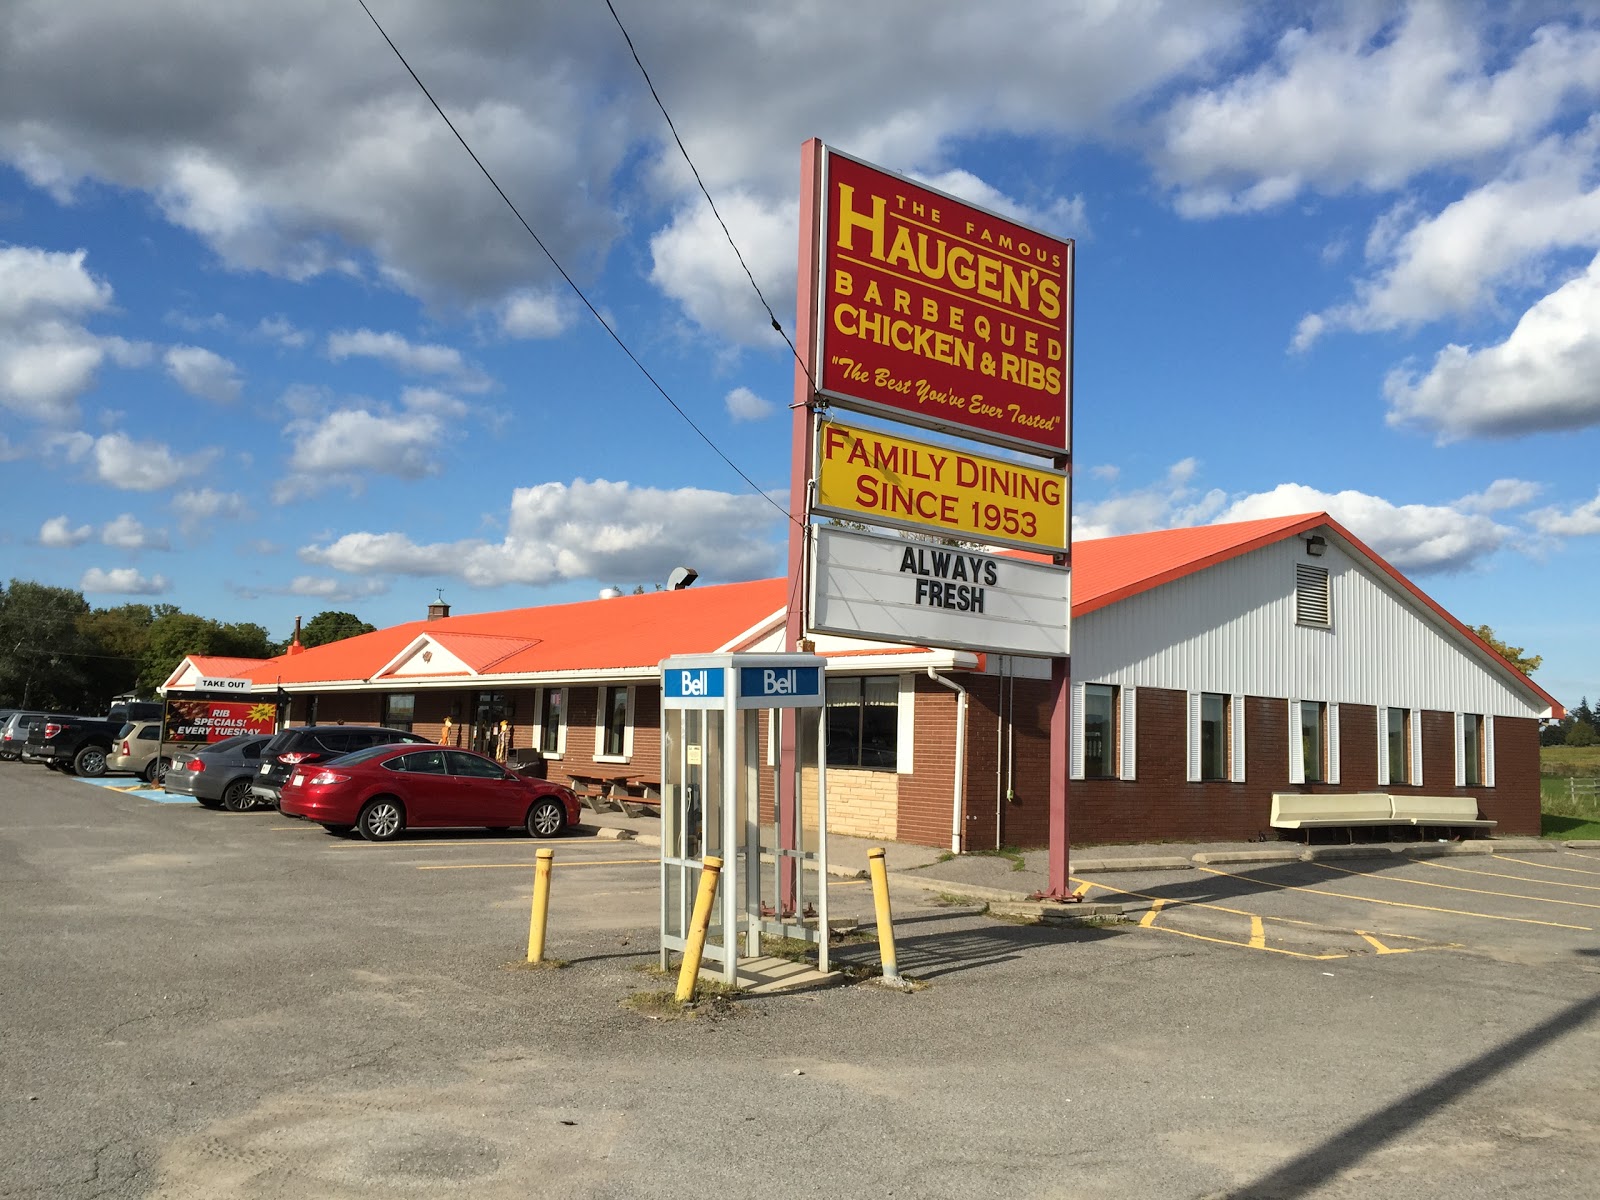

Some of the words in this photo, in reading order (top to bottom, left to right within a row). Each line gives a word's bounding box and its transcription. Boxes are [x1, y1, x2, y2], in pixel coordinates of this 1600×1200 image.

[837, 182, 1061, 319] HAUGEN'S
[896, 195, 941, 223] THE
[966, 221, 1061, 267] FAMOUS
[835, 269, 1062, 361] BARBEQUED
[834, 303, 975, 370] CHICKEN
[980, 351, 996, 377] &
[1001, 352, 1061, 395] RIBS
[832, 356, 870, 383] "The
[874, 368, 911, 394] Best
[915, 379, 966, 409] You've
[968, 394, 1003, 418] Ever
[1007, 404, 1061, 431] Tasted"
[825, 427, 948, 482] FAMILY
[956, 456, 1061, 506] DINING
[856, 474, 959, 524] SINCE
[971, 501, 1037, 538] 1953
[899, 546, 997, 586] ALWAYS
[915, 578, 985, 613] FRESH
[682, 671, 708, 695] Bell
[764, 669, 797, 694] Bell
[178, 726, 212, 735] EVERY
[194, 718, 247, 727] SPECIALS!
[212, 709, 230, 717] RIB
